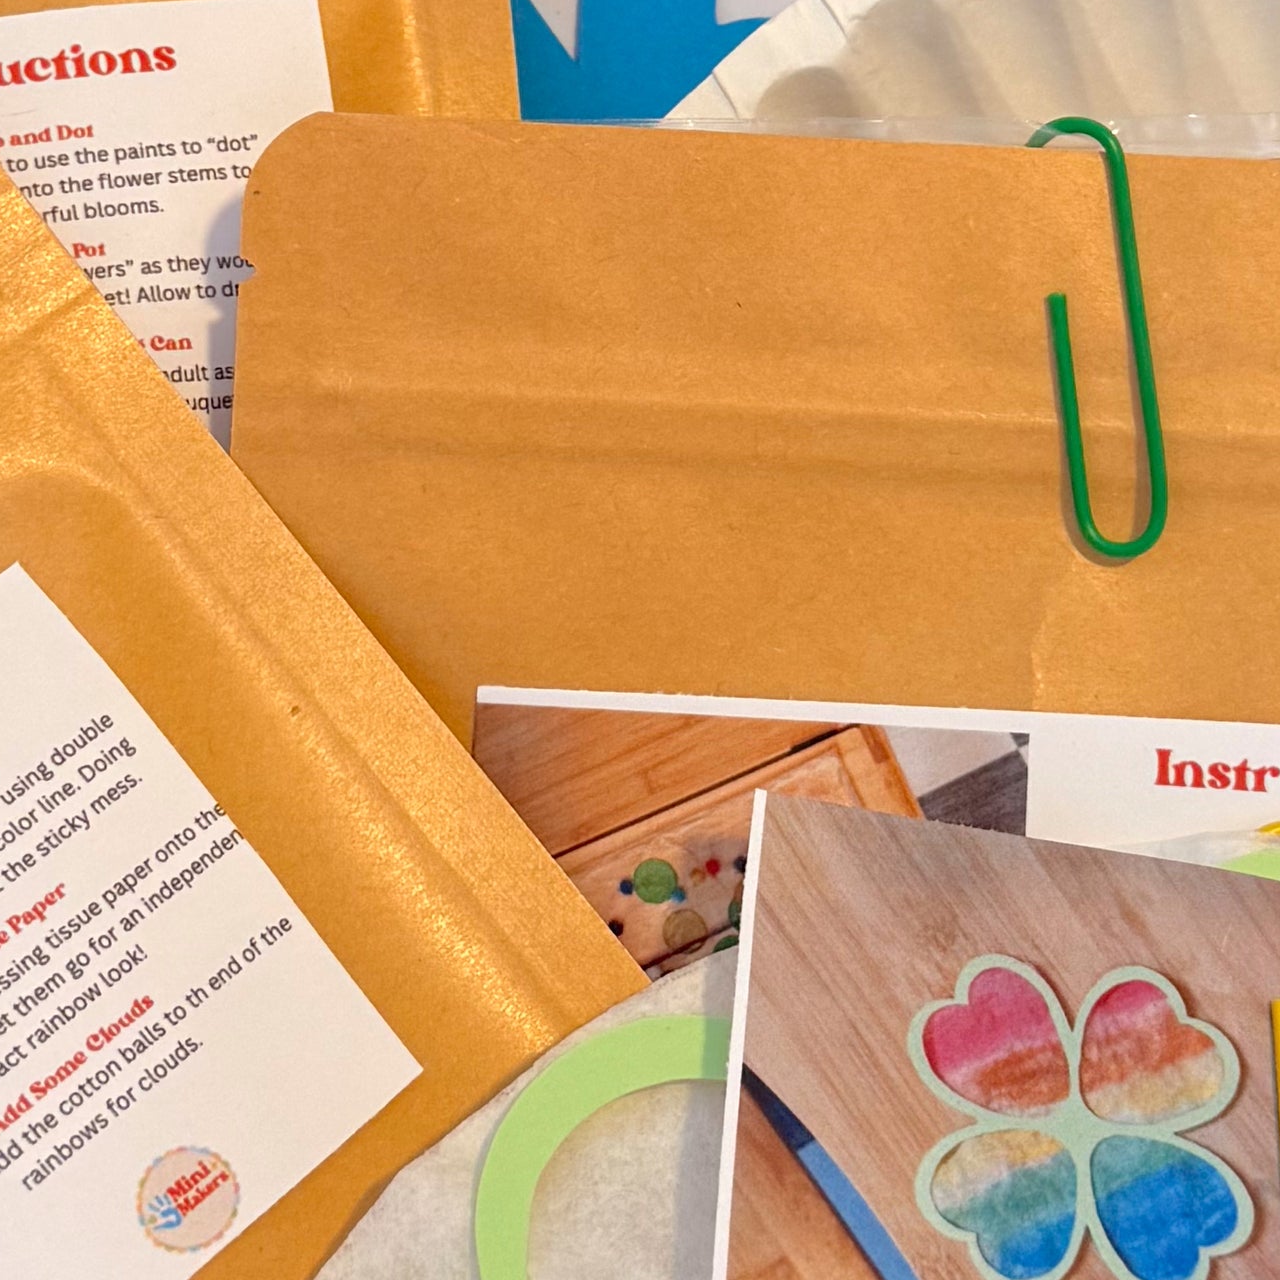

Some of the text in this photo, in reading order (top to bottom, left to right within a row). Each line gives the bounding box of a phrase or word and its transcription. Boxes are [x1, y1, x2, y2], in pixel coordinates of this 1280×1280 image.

[8, 126, 53, 147] and
[55, 124, 94, 141] Dot
[5, 158, 29, 173] to
[33, 152, 70, 170] use
[73, 146, 110, 165] the
[113, 141, 177, 166] paints
[180, 140, 203, 156] to
[18, 182, 54, 198] nto
[58, 176, 94, 194] the
[96, 171, 163, 190] flower
[166, 166, 228, 184] stems
[82, 199, 165, 220] blooms.
[71, 242, 106, 259] Pot
[140, 259, 163, 276] as
[165, 255, 211, 275] they
[136, 285, 191, 304] Allow
[194, 283, 217, 300] to
[149, 334, 193, 352] Can
[49, 714, 114, 767] double
[36, 782, 82, 814] line.
[76, 736, 137, 784] Doing
[4, 882, 66, 935] Paper
[25, 981, 102, 1050] rainbow
[97, 943, 148, 988] look!
[20, 1112, 59, 1146] the
[58, 1059, 123, 1116] cotton
[117, 1021, 167, 1064] balls
[162, 1004, 187, 1026] to
[184, 986, 210, 1009] th
[207, 954, 243, 991] end
[241, 936, 262, 963] of
[259, 917, 293, 946] the
[28, 1050, 88, 1101] Some
[85, 994, 155, 1052] Clouds
[165, 1159, 212, 1204] Mini
[175, 1169, 231, 1217] Makers
